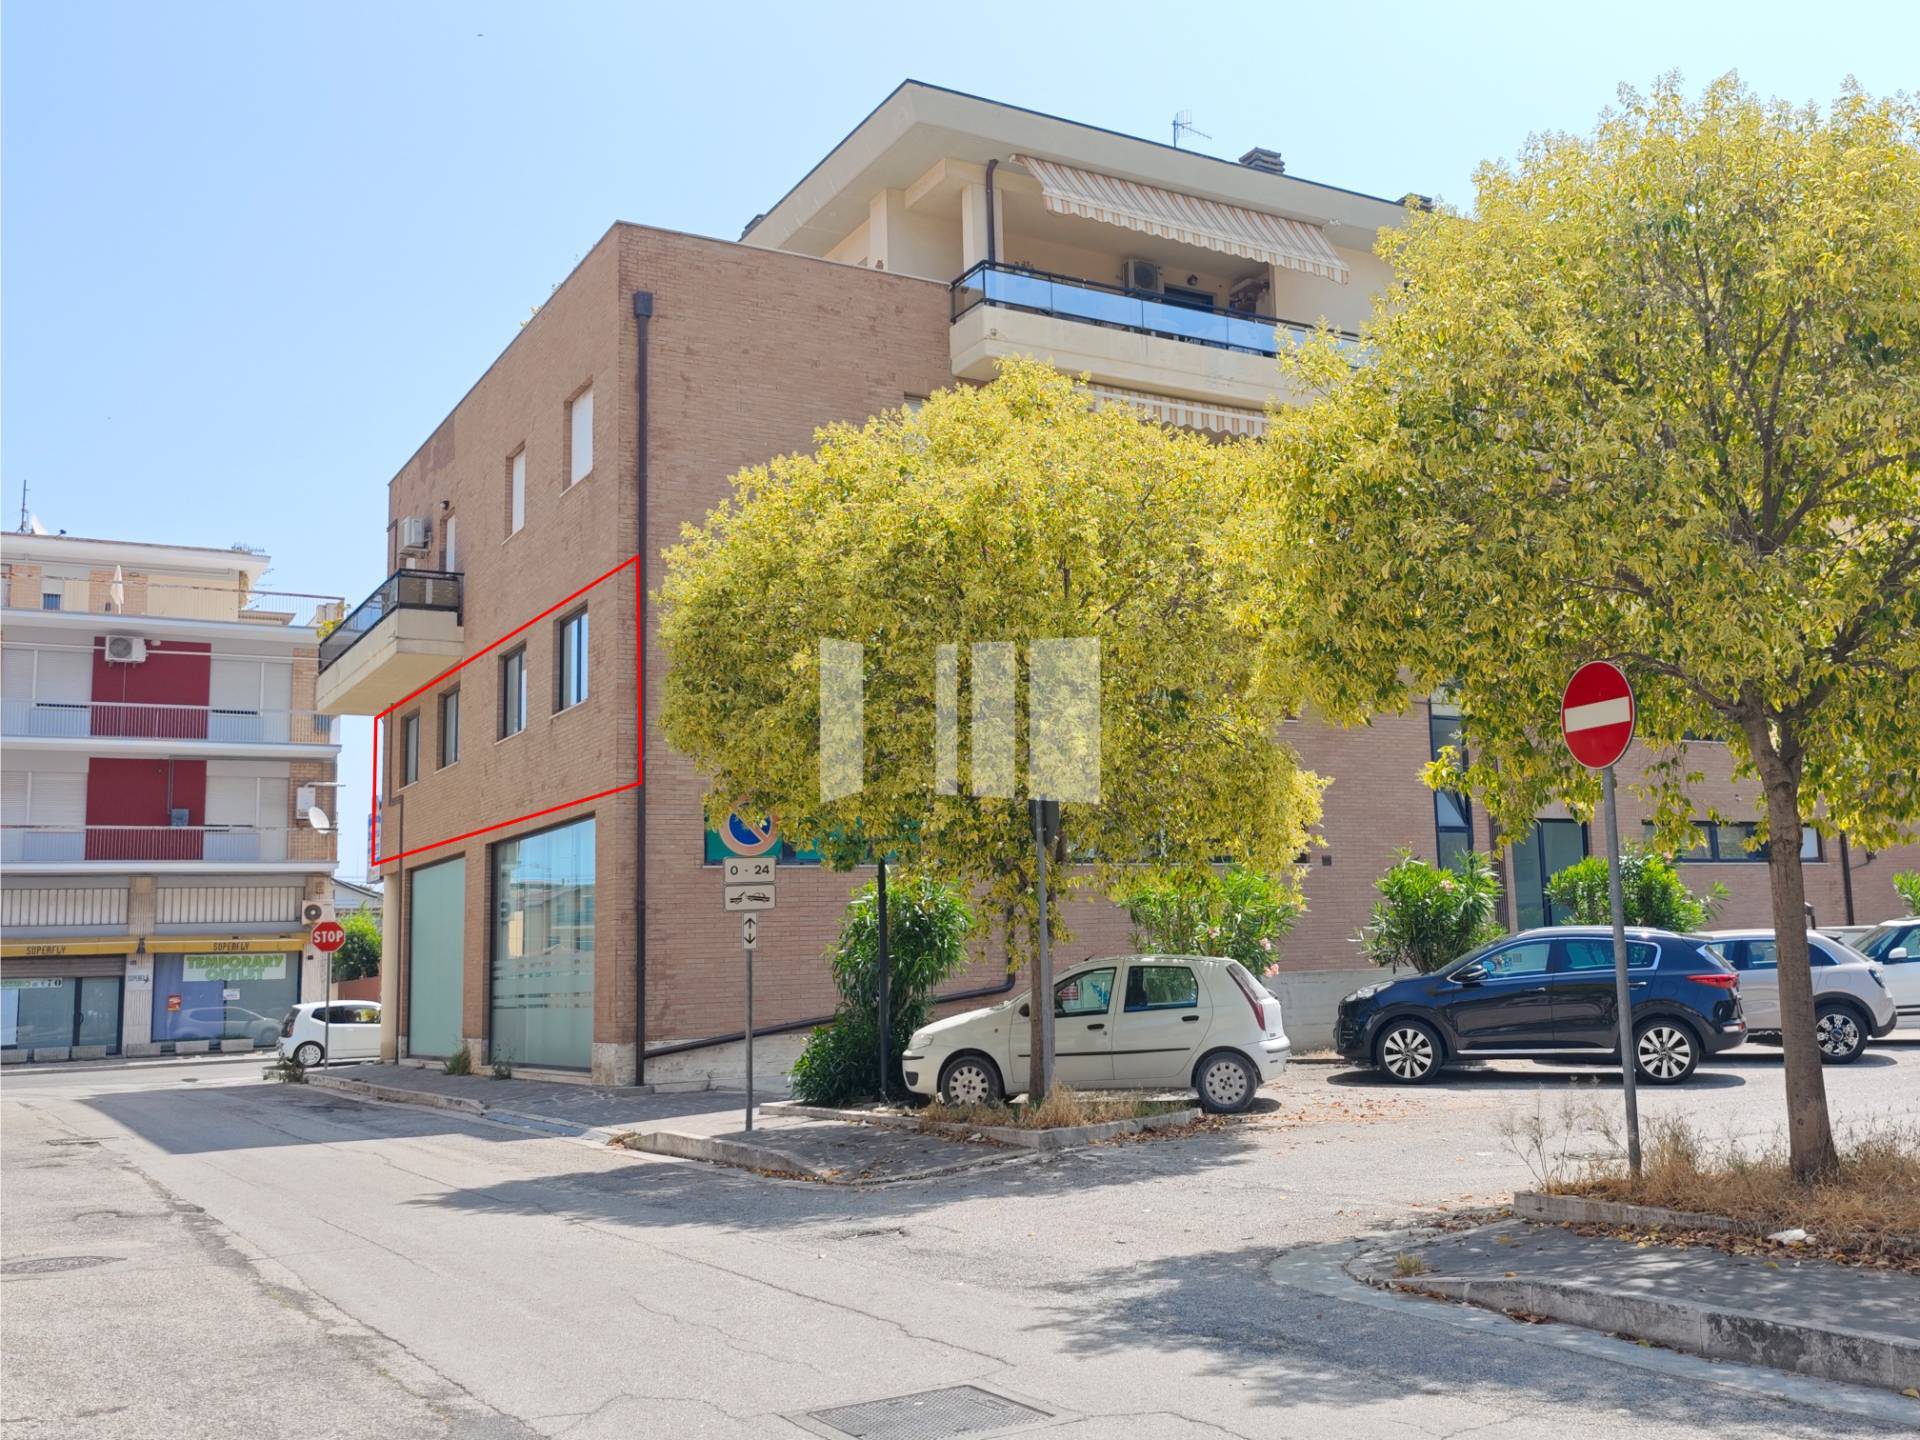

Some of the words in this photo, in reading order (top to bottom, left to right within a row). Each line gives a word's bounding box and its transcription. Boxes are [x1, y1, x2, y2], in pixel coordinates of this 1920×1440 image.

[730, 865, 739, 876] 0
[754, 865, 770, 875] 24
[313, 930, 344, 943] STOP
[26, 945, 65, 955] SUPERFLY
[213, 943, 250, 951] SUPERFLY
[186, 955, 284, 968] TEMPORARY
[205, 968, 263, 981] OUTLET
